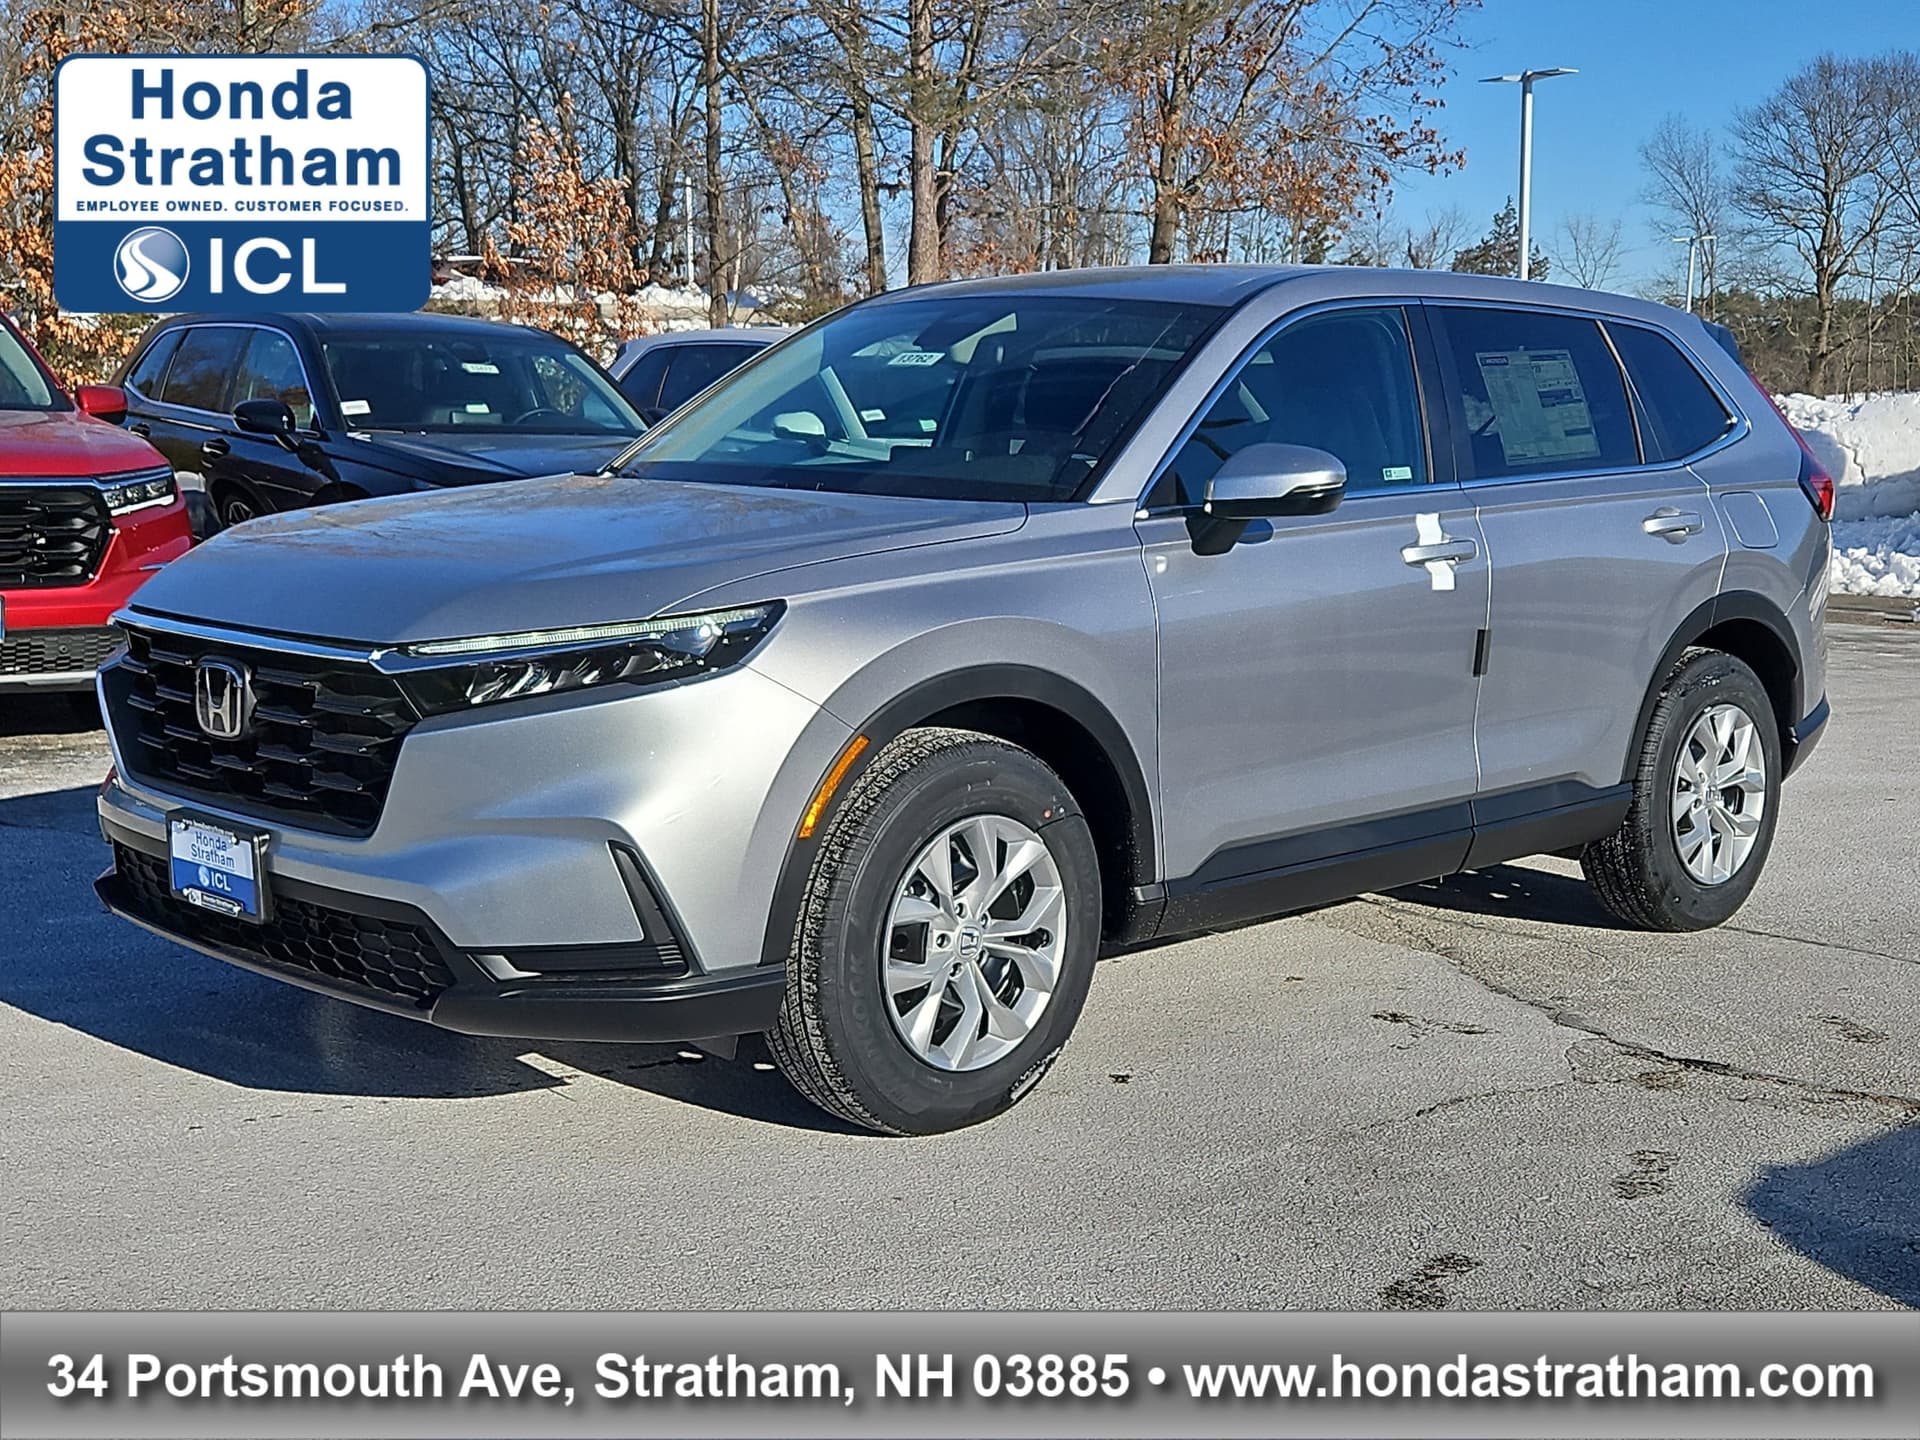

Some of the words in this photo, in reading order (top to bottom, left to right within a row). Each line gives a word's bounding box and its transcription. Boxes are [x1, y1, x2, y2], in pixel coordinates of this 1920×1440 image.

[195, 831, 228, 851] Honda
[191, 844, 235, 868] Stratham
[210, 871, 232, 892] ICL
